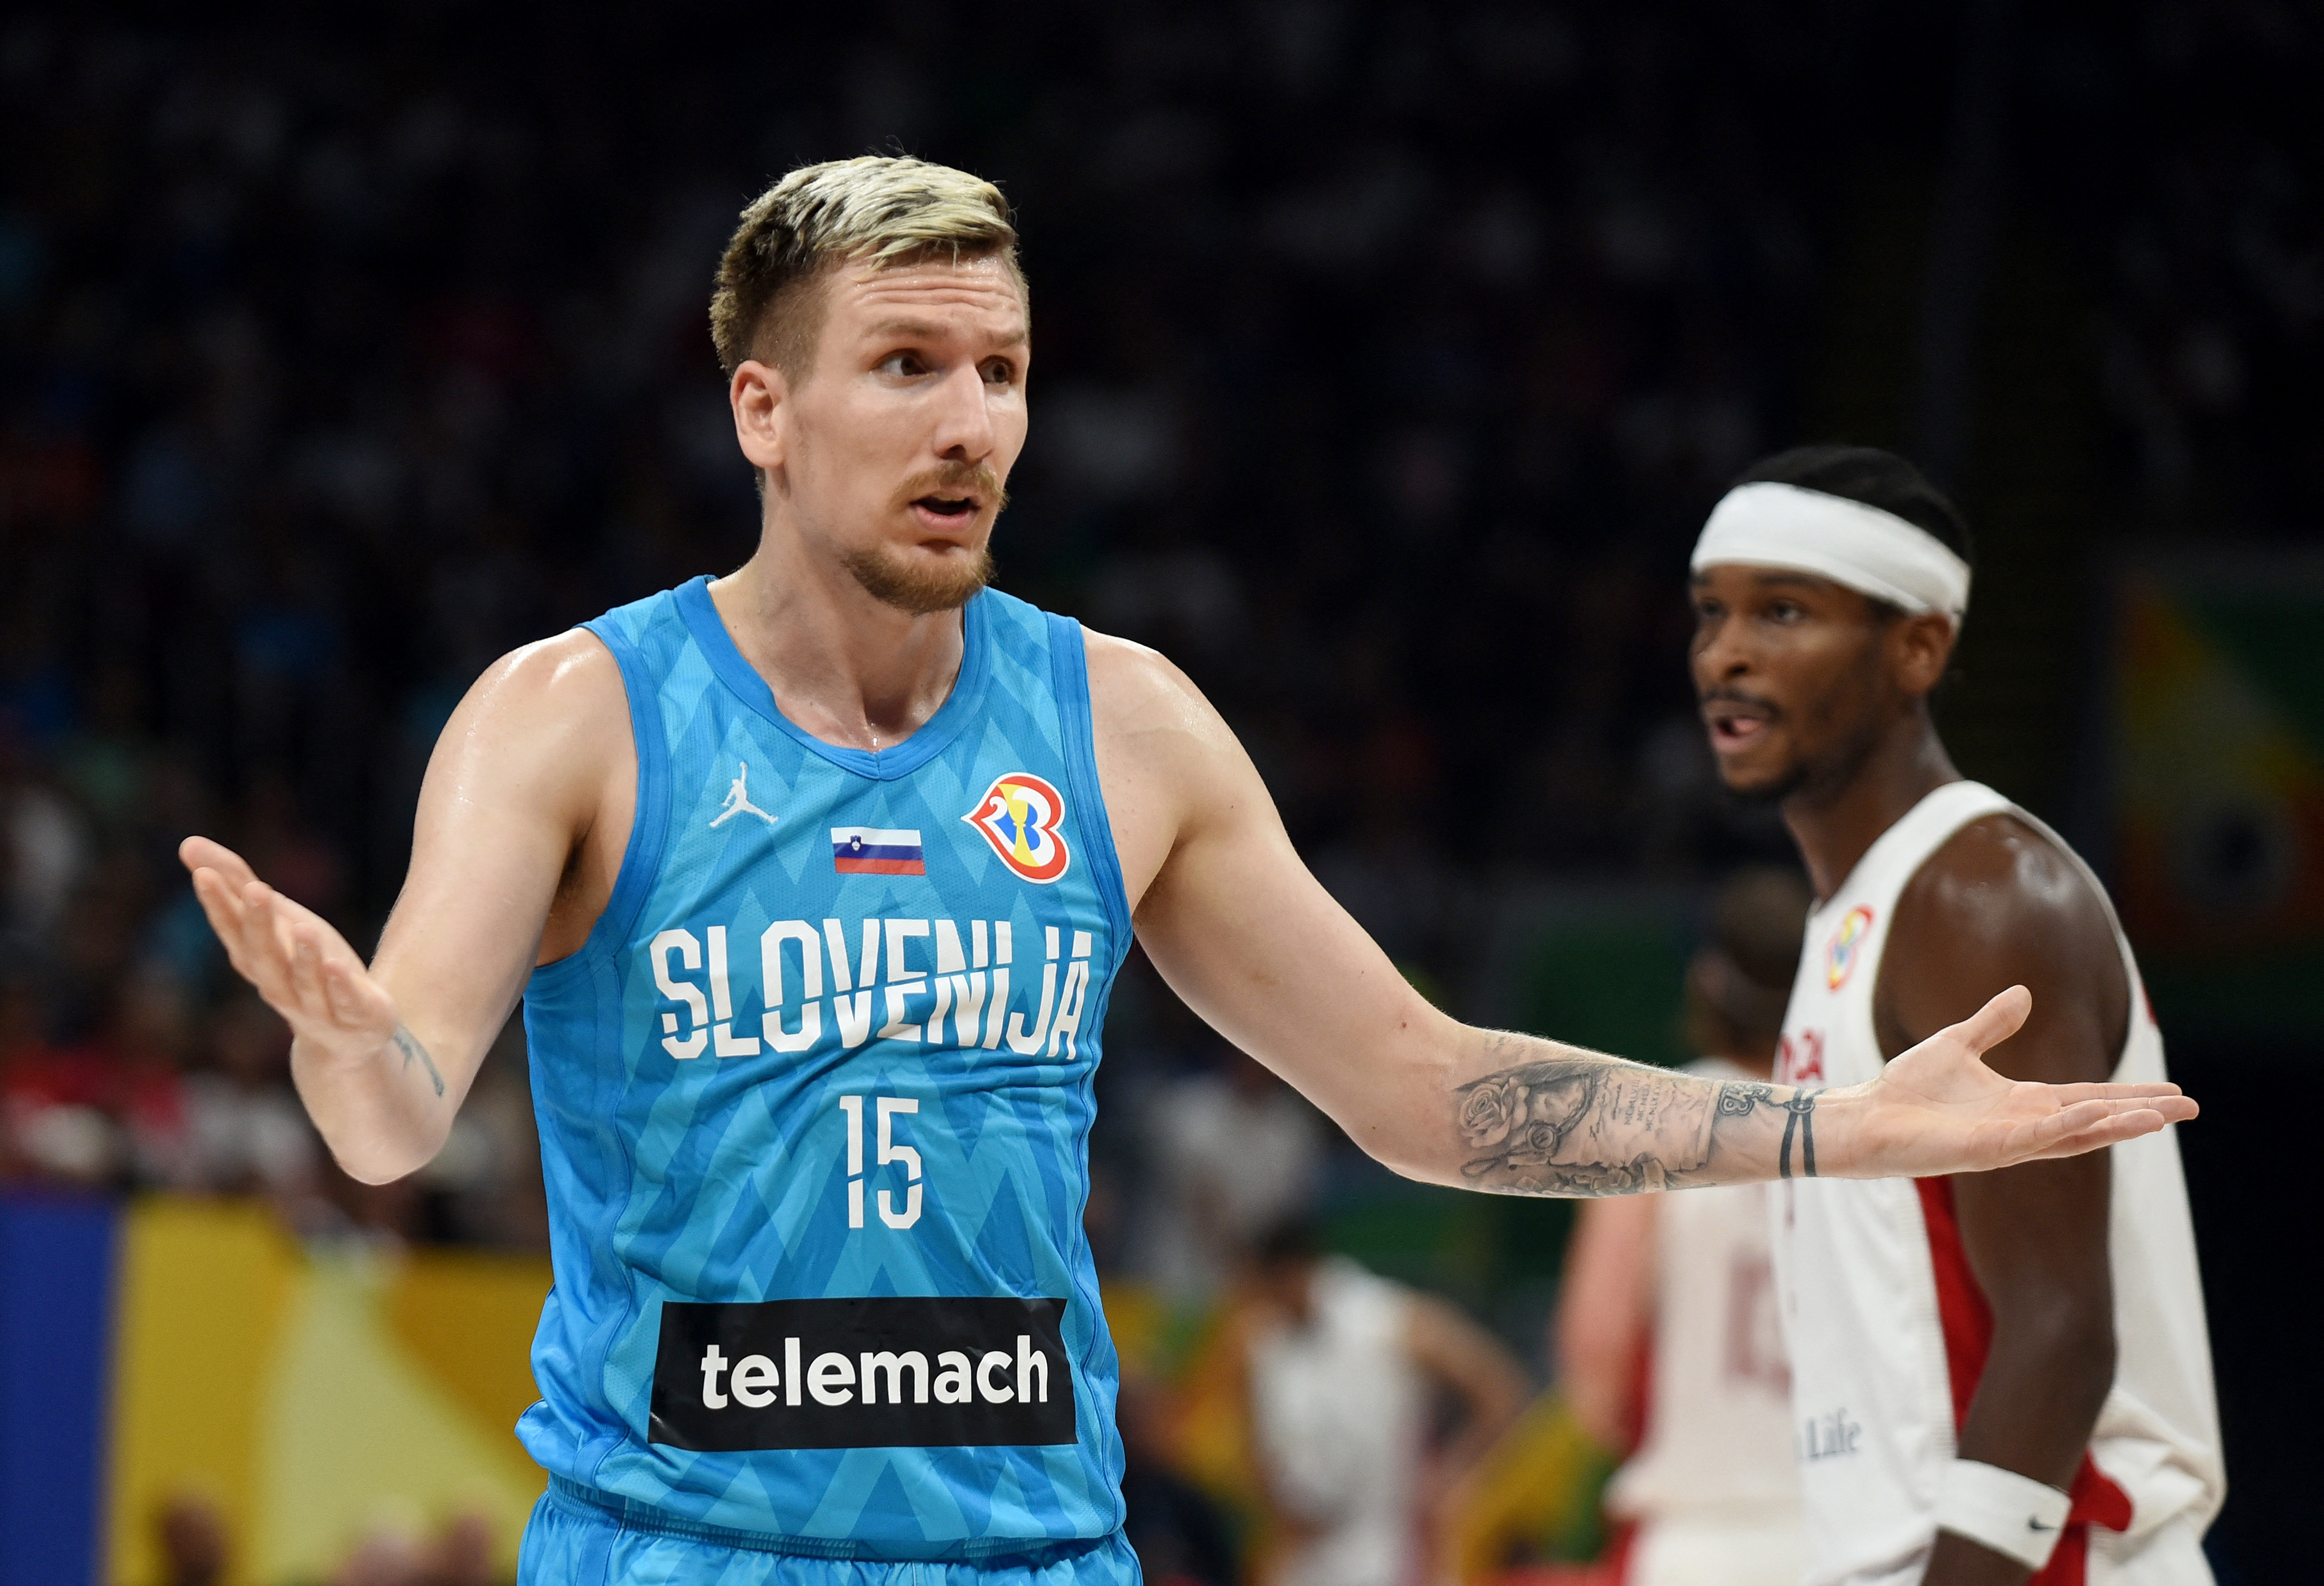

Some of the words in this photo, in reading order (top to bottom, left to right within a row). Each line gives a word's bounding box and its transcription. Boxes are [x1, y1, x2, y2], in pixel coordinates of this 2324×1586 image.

[649, 918, 1092, 1060] SLOVENIJA
[839, 1095, 922, 1229] 15
[700, 1335, 1048, 1409] telemach
